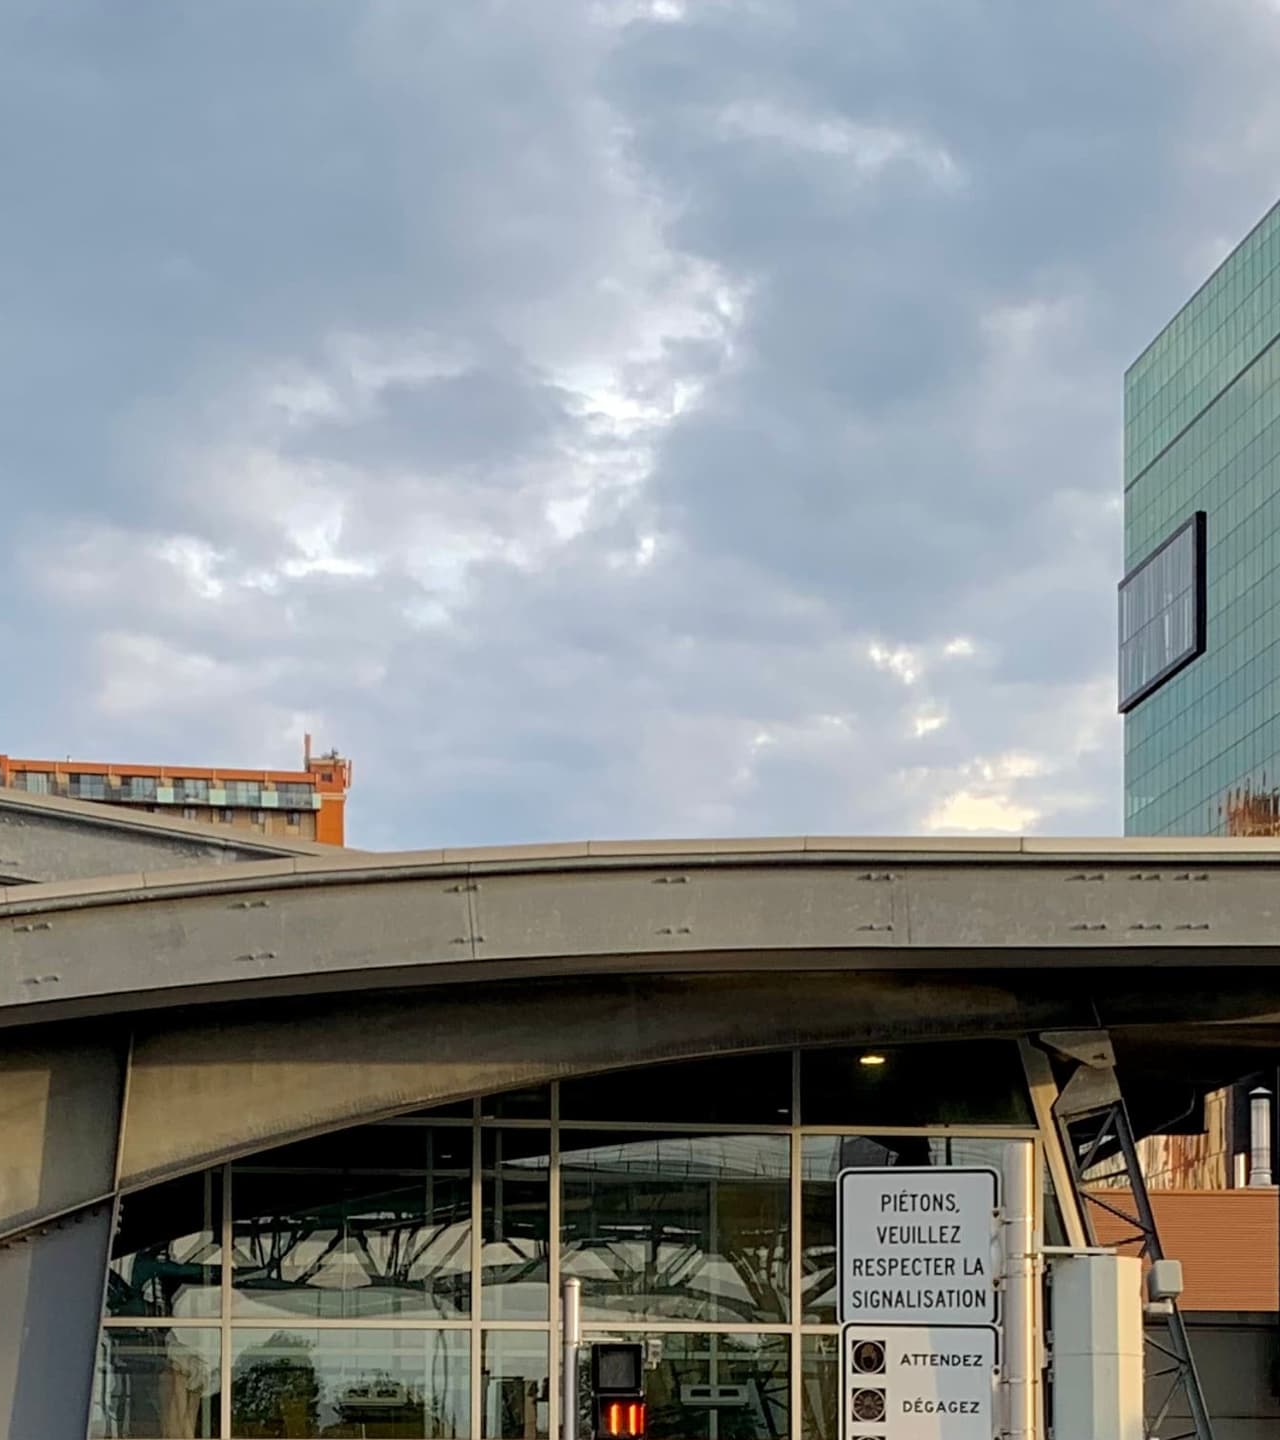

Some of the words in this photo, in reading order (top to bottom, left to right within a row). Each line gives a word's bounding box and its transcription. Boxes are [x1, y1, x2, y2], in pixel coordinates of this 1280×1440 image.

[881, 1189, 960, 1213] PIÉTONS,
[876, 1226, 961, 1244] VEUILLEZ
[852, 1258, 956, 1276] RESPECTER
[963, 1257, 984, 1276] LA
[852, 1289, 986, 1308] SIGNALISATION
[900, 1354, 983, 1367] ATTENDEZ
[902, 1397, 980, 1413] DÉGAGEZ
